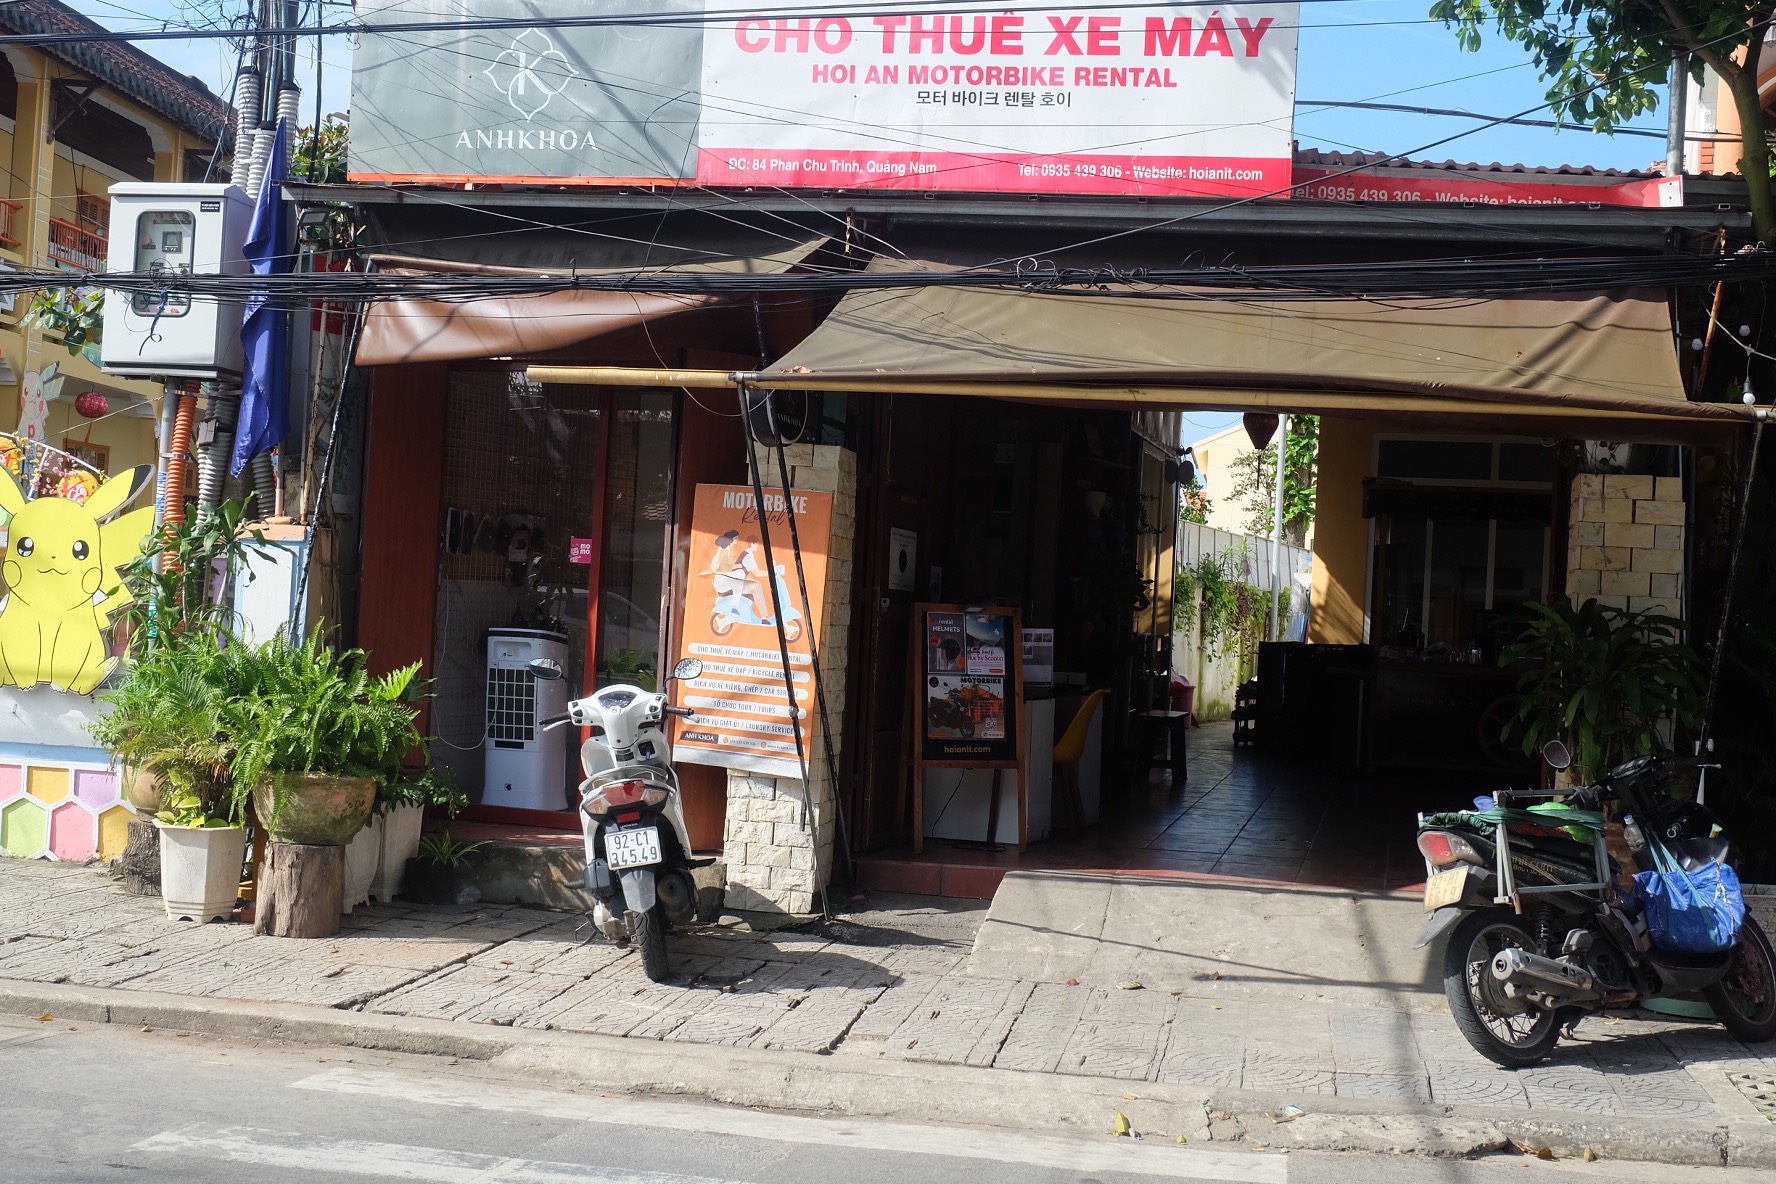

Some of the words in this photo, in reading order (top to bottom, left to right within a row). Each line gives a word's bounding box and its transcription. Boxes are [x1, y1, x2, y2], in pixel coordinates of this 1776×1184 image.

[734, 14, 853, 54] CHO
[873, 10, 1025, 55] THUÊ
[1043, 16, 1122, 56] XE
[1143, 11, 1275, 57] MÁY
[812, 64, 857, 84] HOI
[864, 65, 899, 85] AN
[908, 65, 1065, 86] MOTORBIKE
[1074, 67, 1178, 88] RENTAL
[916, 90, 947, 106] 모터
[952, 90, 1000, 106] 바이크
[1004, 91, 1036, 107] 렌탈
[1040, 91, 1071, 107] 호이
[455, 130, 599, 150] ANHKHOA
[752, 159, 767, 171] 84
[770, 159, 800, 171] Phan
[803, 159, 828, 171] Chu
[866, 159, 906, 177] Quảng
[909, 162, 937, 174] Nam
[1018, 164, 1039, 177] Tel:
[1041, 164, 1071, 177] 0935
[1074, 165, 1097, 178] 439
[1099, 166, 1123, 178] 306
[1132, 165, 1186, 179] Website:
[1189, 167, 1263, 181] hoianit.com
[1317, 186, 1355, 201] 0935
[1360, 188, 1389, 201] 439
[1393, 190, 1422, 202] 306
[932, 625, 961, 633] HELMETS
[960, 677, 1002, 685] MOTORBIKE
[943, 745, 991, 754] hoianit.com
[613, 830, 650, 850] 92-C1
[610, 846, 658, 866] 345.49
